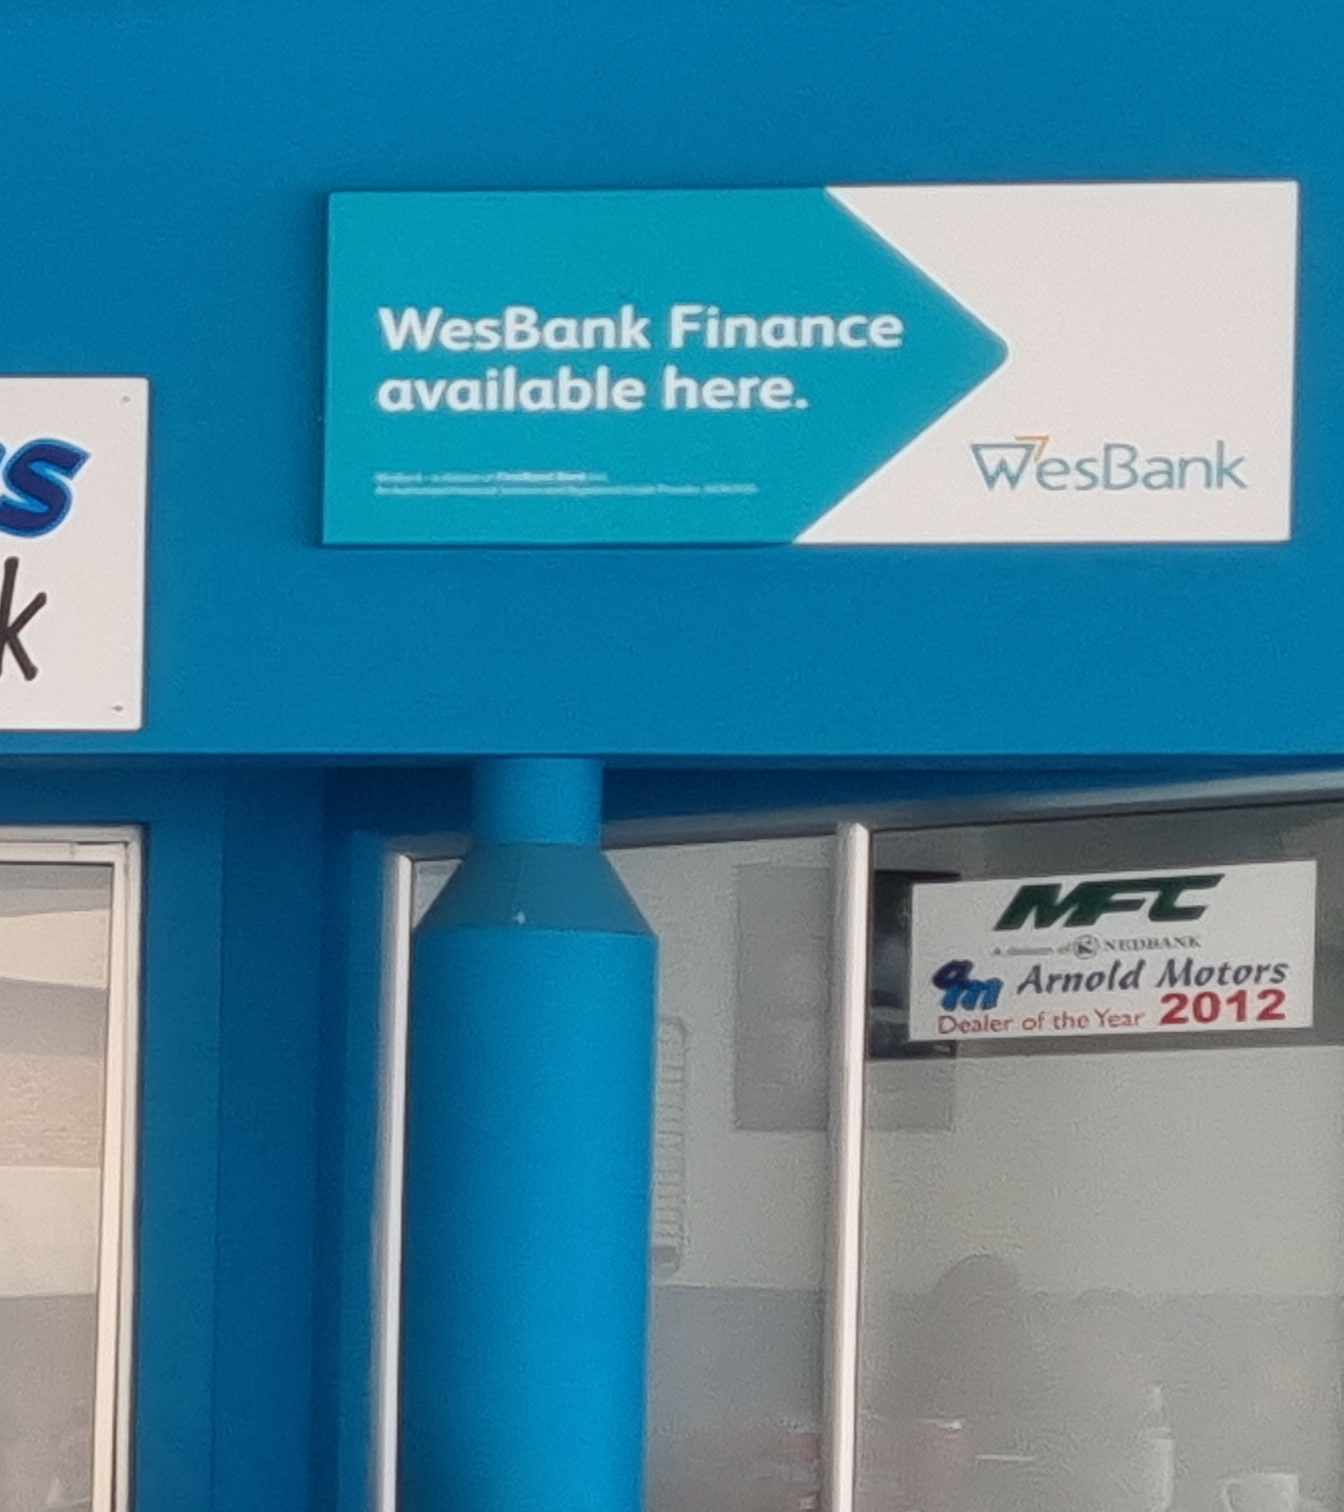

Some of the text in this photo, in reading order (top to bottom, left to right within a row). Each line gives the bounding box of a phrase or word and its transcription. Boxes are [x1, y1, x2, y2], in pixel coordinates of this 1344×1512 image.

[378, 304, 904, 351] WesBank Finance
[377, 365, 810, 413] available here.
[970, 436, 1248, 492] WesBank
[993, 873, 1225, 931] MFC
[1105, 936, 1202, 951] NEDBANK
[1016, 958, 1289, 995] Arnold Motors
[937, 988, 1287, 1035] Dealer of the Year 2012
